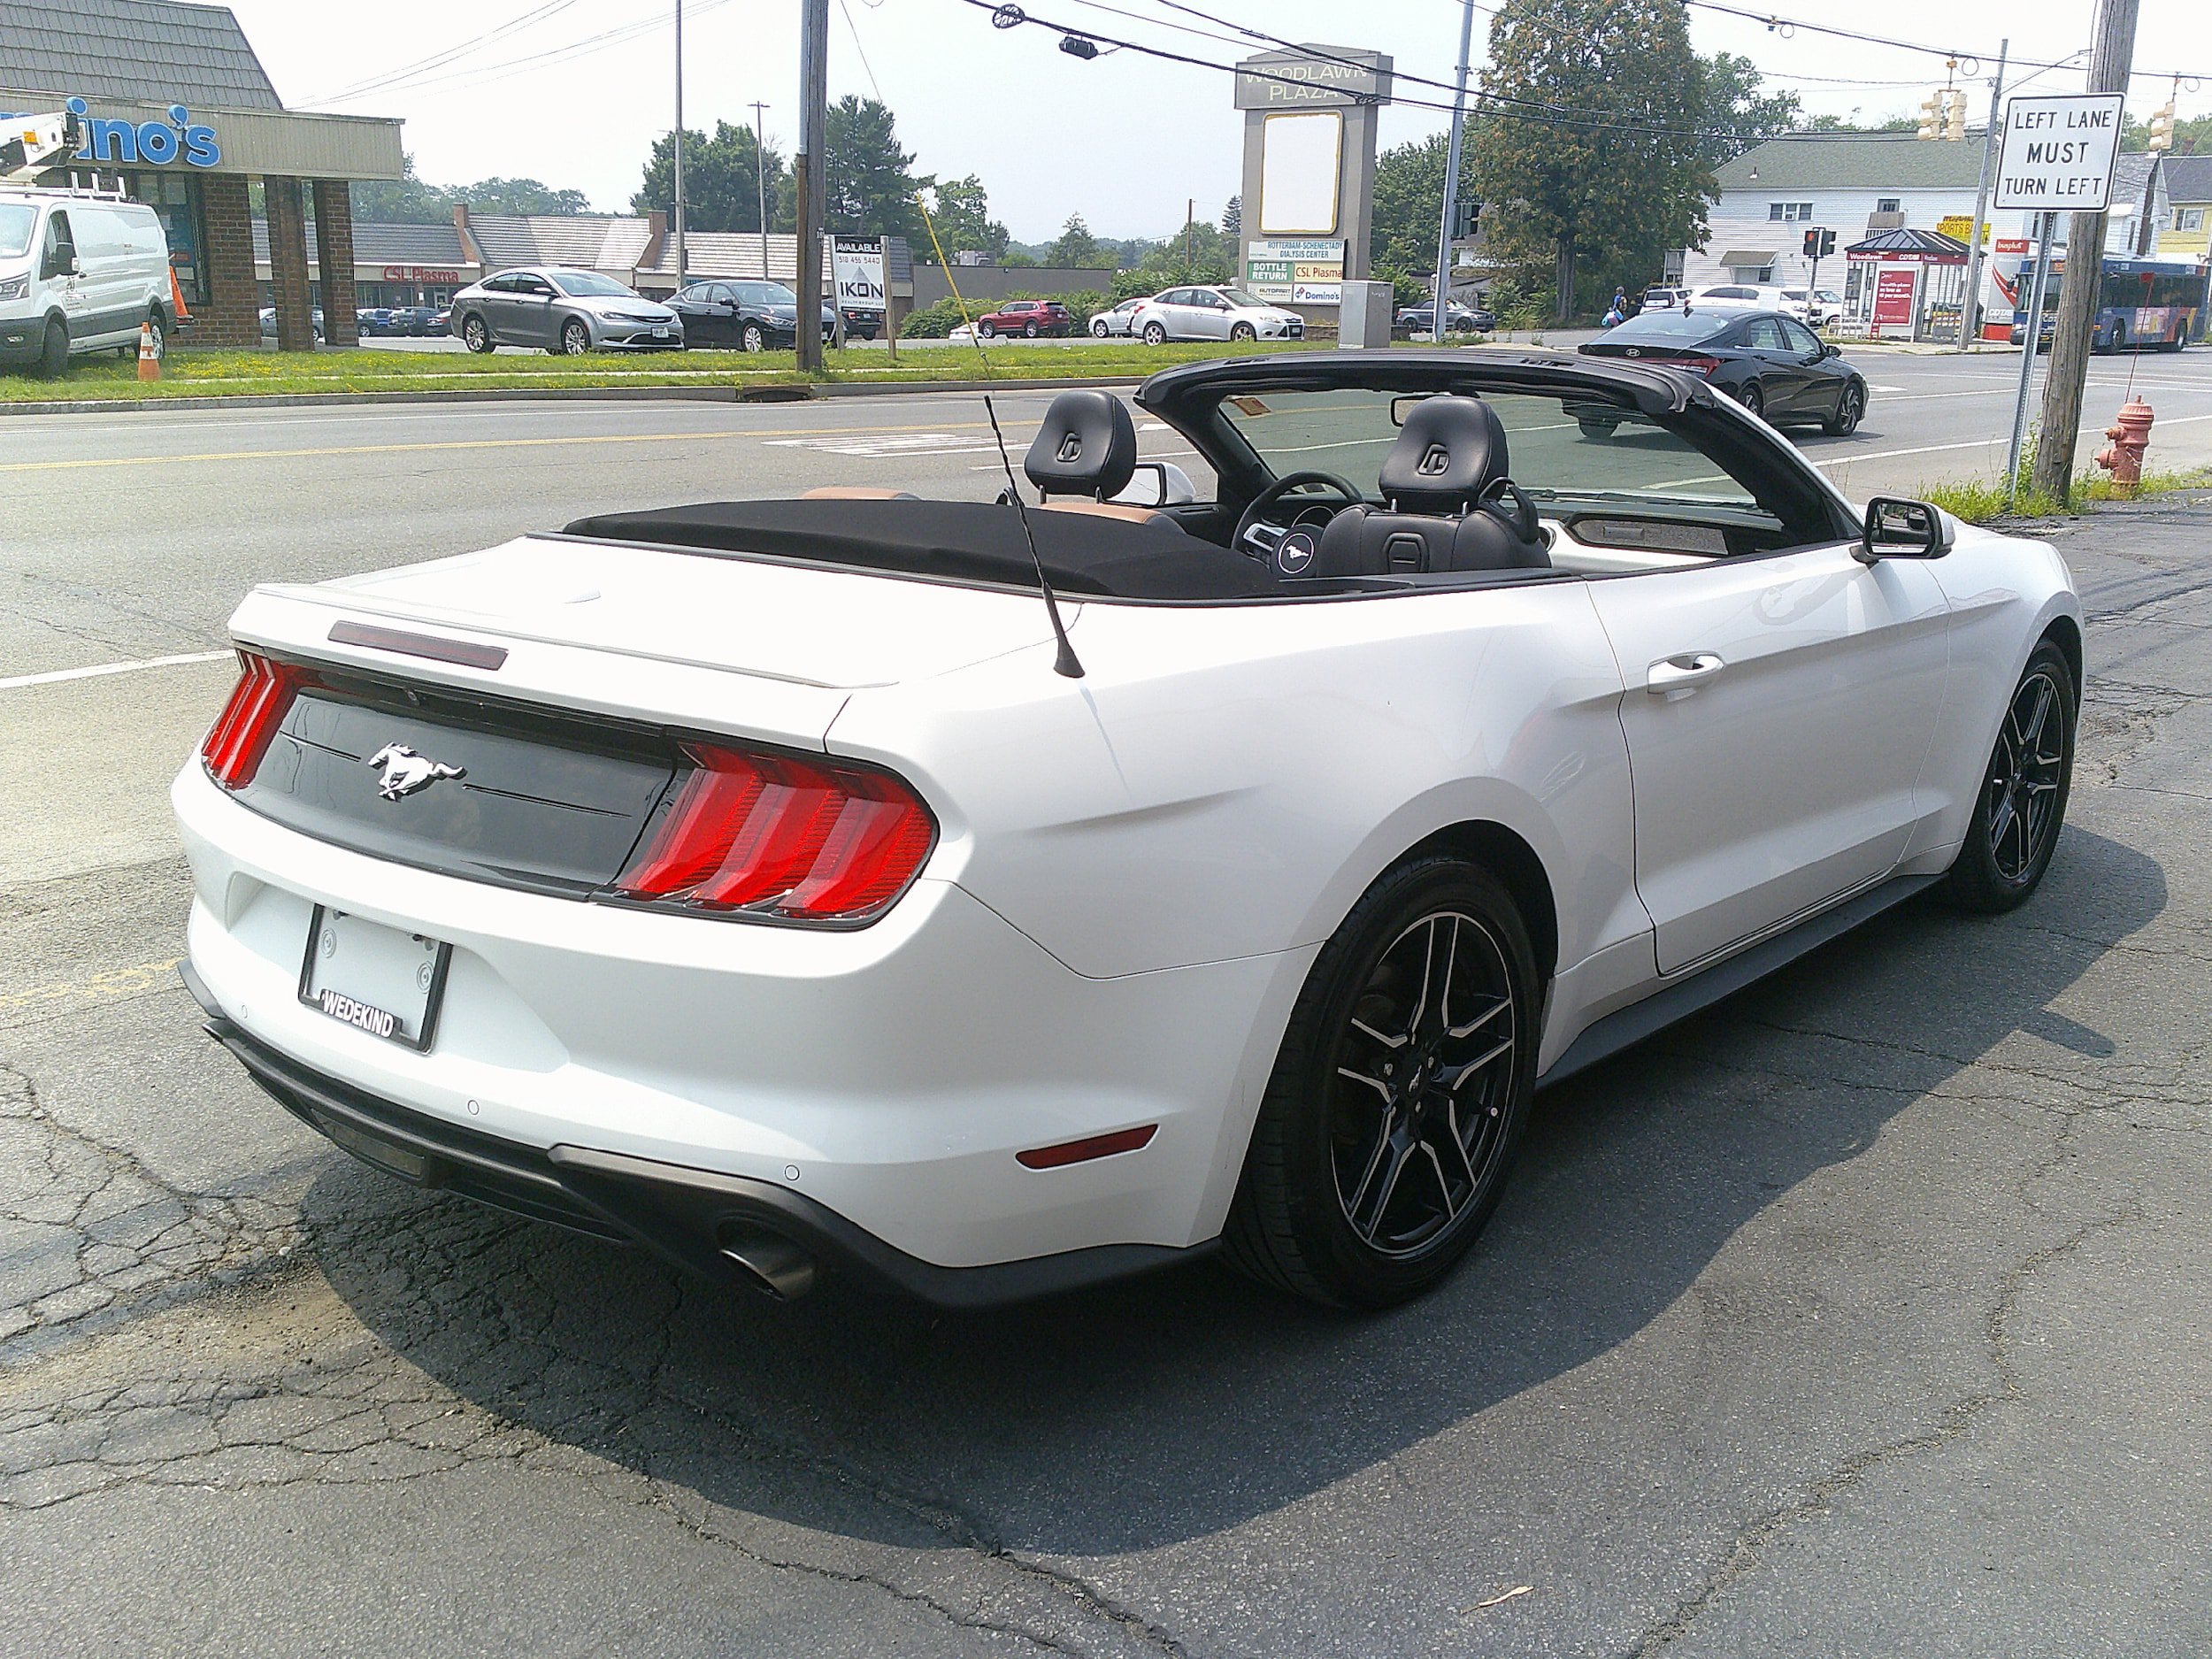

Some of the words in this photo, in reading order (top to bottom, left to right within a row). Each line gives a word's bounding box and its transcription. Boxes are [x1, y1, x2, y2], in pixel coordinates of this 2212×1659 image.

[1245, 65, 1368, 83] WOODLAWN
[1269, 84, 1339, 101] PLAZA
[2015, 111, 2057, 129] LEFT
[2067, 111, 2113, 128] LANE
[2026, 142, 2089, 164] MUST
[2005, 178, 2047, 195] TURN
[2055, 178, 2102, 195] LEFT
[836, 242, 881, 252] AVAILABLE
[383, 265, 408, 282] CSL
[411, 266, 459, 283] Plasma
[1252, 272, 1287, 280] RETURN
[1253, 263, 1287, 272] BOTTLE
[1295, 267, 1310, 277] CSL
[1313, 267, 1342, 278] Plasma
[840, 281, 884, 298] IKON
[321, 989, 394, 1038] WEDEKIND
